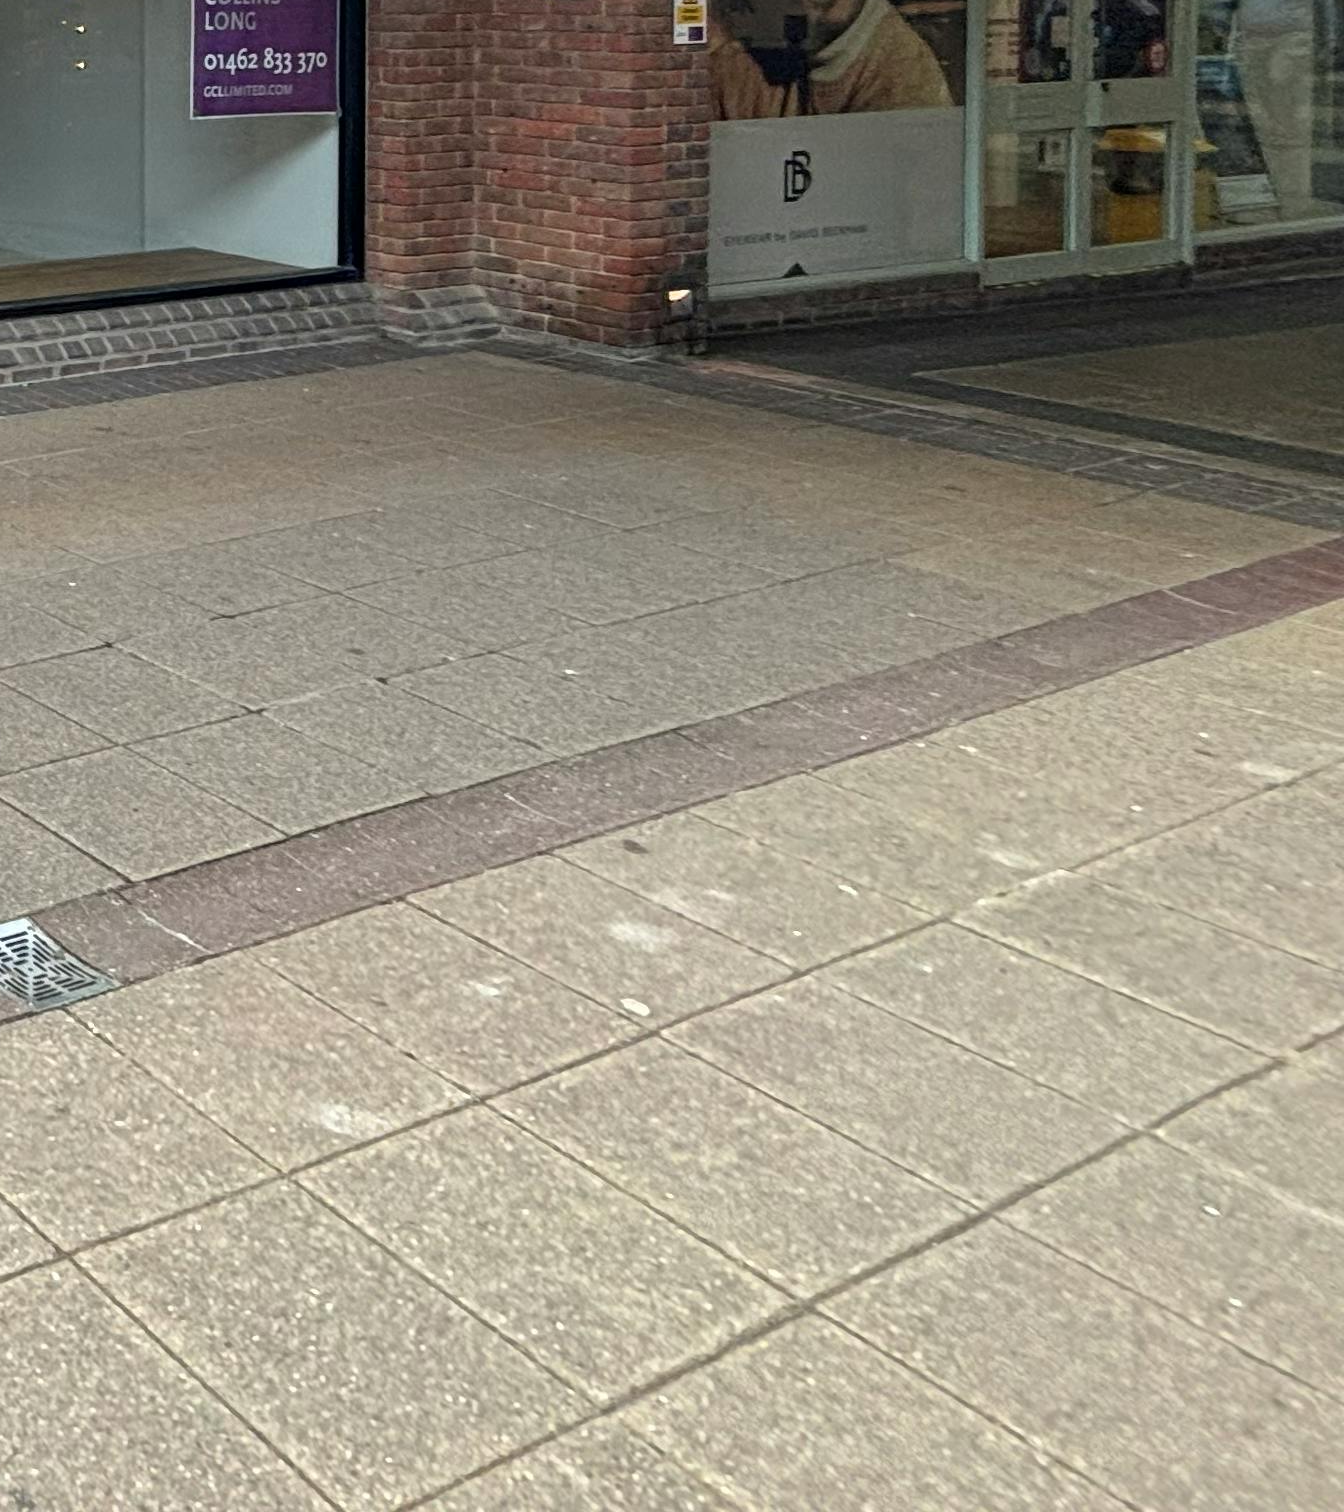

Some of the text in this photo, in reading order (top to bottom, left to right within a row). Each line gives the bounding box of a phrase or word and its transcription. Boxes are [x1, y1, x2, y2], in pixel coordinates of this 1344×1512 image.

[205, 12, 256, 31] LONG
[204, 48, 328, 75] 01462 833 370
